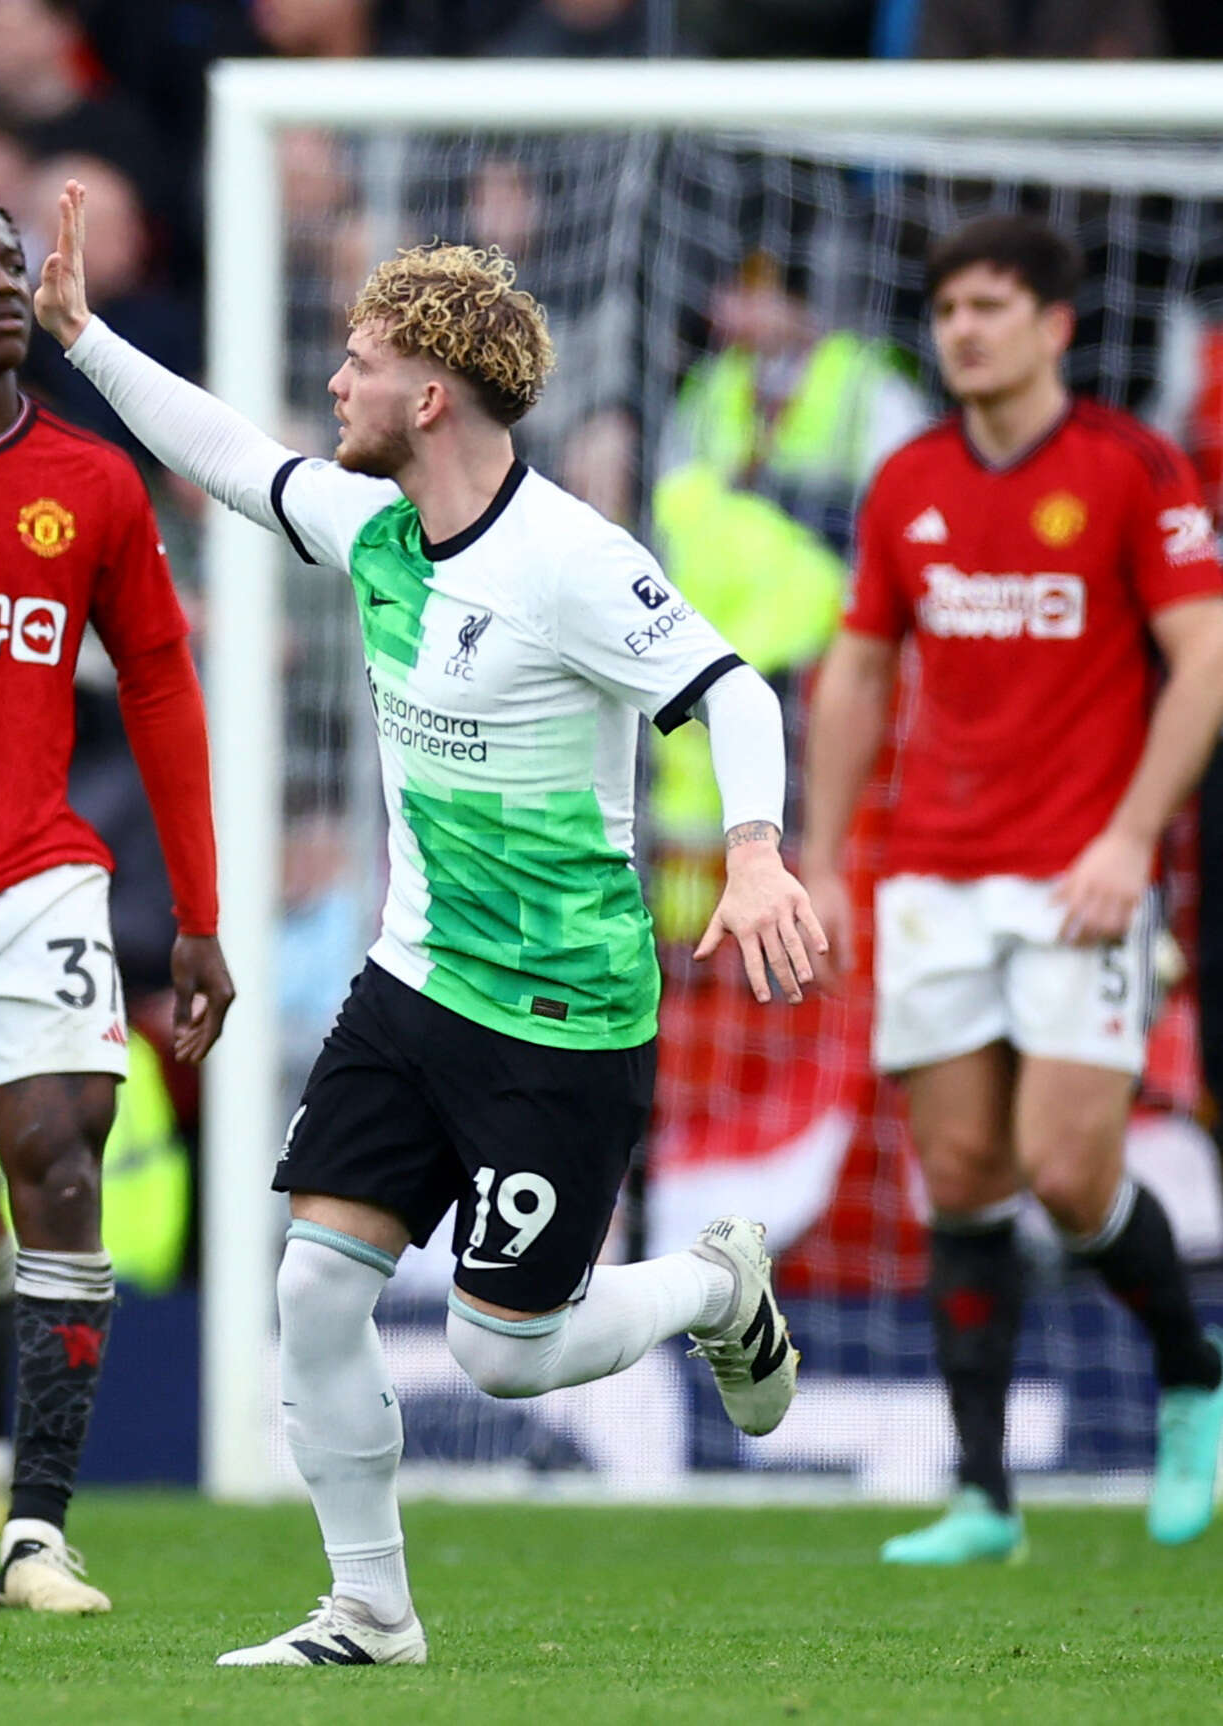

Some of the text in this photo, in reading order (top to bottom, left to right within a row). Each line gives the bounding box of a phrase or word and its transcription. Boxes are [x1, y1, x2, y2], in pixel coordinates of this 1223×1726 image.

[444, 660, 474, 682] LFC
[383, 690, 479, 738] standard
[383, 717, 487, 763] chartered
[469, 1166, 557, 1258] 19
